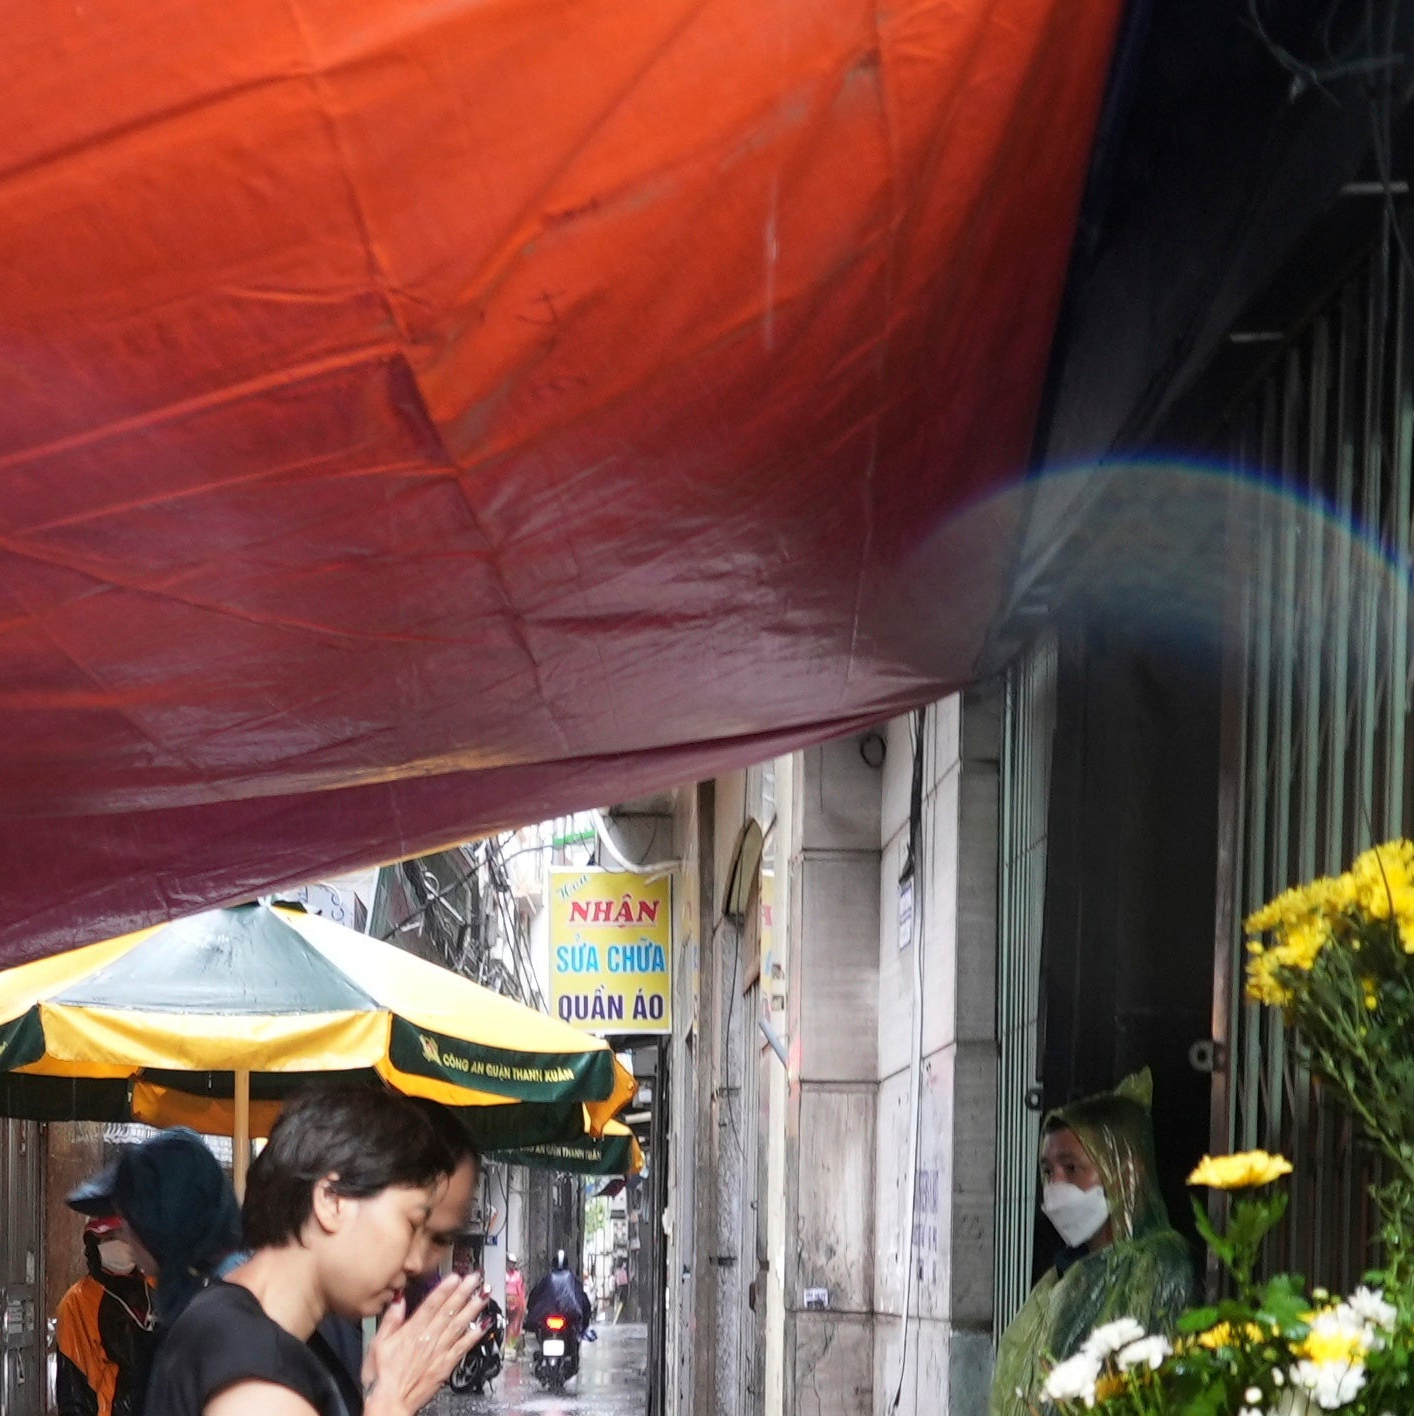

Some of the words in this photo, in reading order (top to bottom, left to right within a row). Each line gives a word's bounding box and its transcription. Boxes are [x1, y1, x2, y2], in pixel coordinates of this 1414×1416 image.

[569, 893, 660, 928] NHẬN
[556, 933, 600, 973] SỬA
[607, 936, 666, 972] CHỮA
[558, 984, 624, 1023] QUẦN
[632, 988, 664, 1020] ÁO
[443, 1053, 469, 1072] CÔNG
[470, 1061, 484, 1073] AN
[486, 1062, 510, 1081] QUẬN
[512, 1067, 543, 1082] THANH
[544, 1066, 575, 1083] XUÂN
